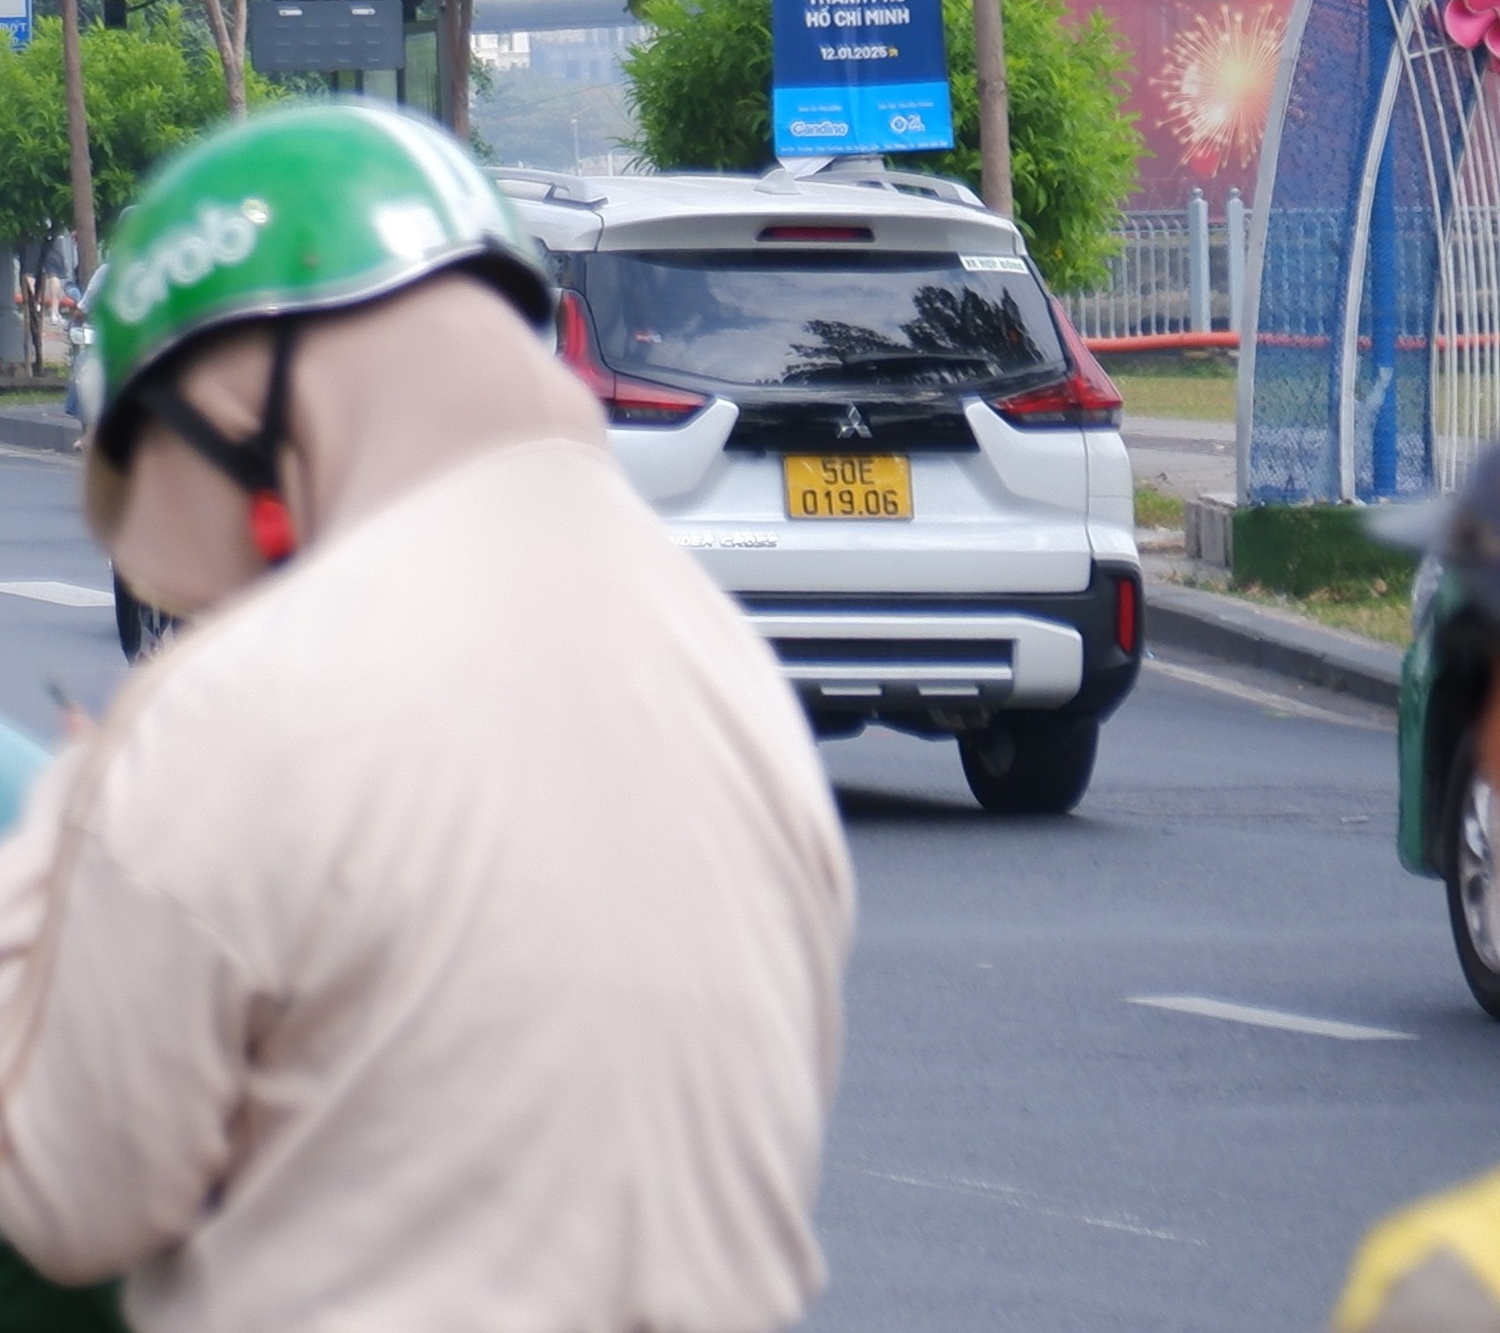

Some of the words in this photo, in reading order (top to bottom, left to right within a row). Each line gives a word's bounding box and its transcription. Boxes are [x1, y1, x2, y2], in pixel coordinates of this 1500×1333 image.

[805, 6, 831, 28] HỒ
[834, 6, 862, 27] CHÍ
[865, 8, 910, 25] MINH
[110, 203, 258, 323] Grab
[821, 458, 876, 486] 50E
[802, 489, 899, 516] 019.06
